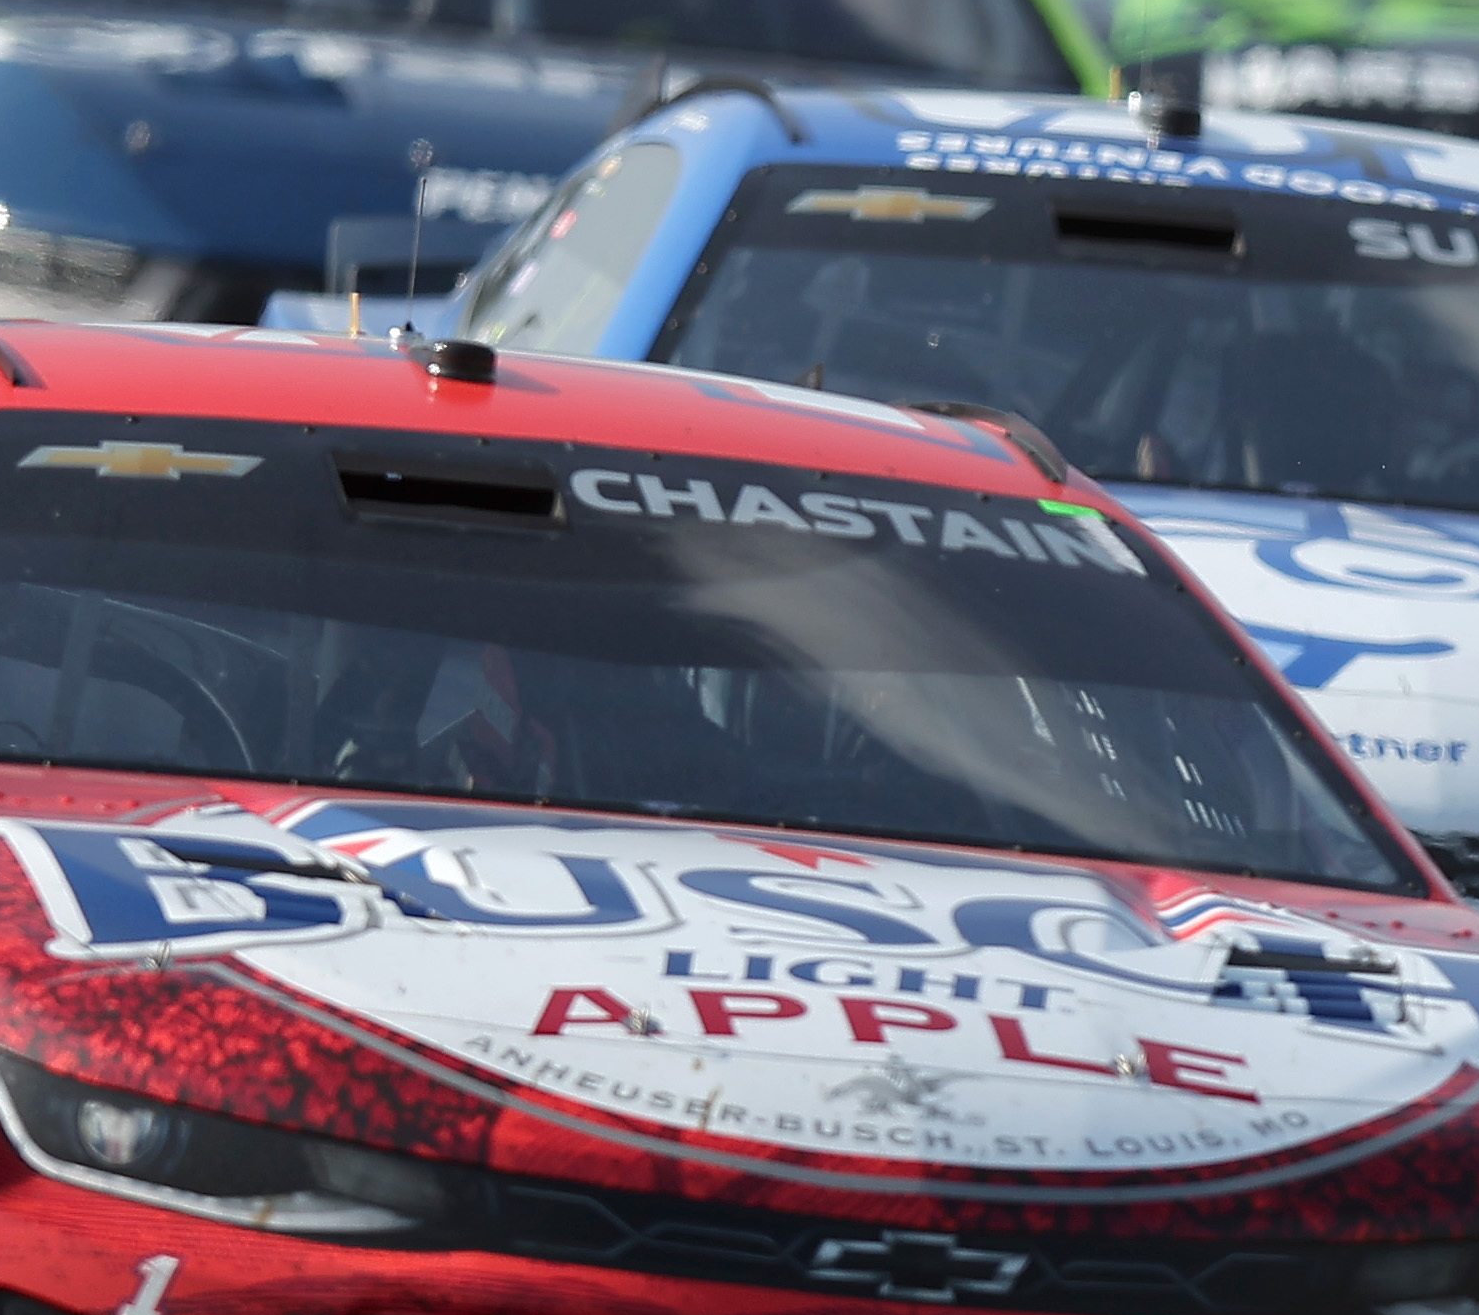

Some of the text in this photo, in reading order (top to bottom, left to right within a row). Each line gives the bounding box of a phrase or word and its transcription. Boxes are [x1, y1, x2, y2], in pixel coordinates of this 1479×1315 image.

[569, 469, 1127, 570] CHASTAIN
[665, 949, 1074, 1014] LIGHT
[532, 987, 1263, 1105] APPLE
[1258, 1108, 1310, 1146] MO
